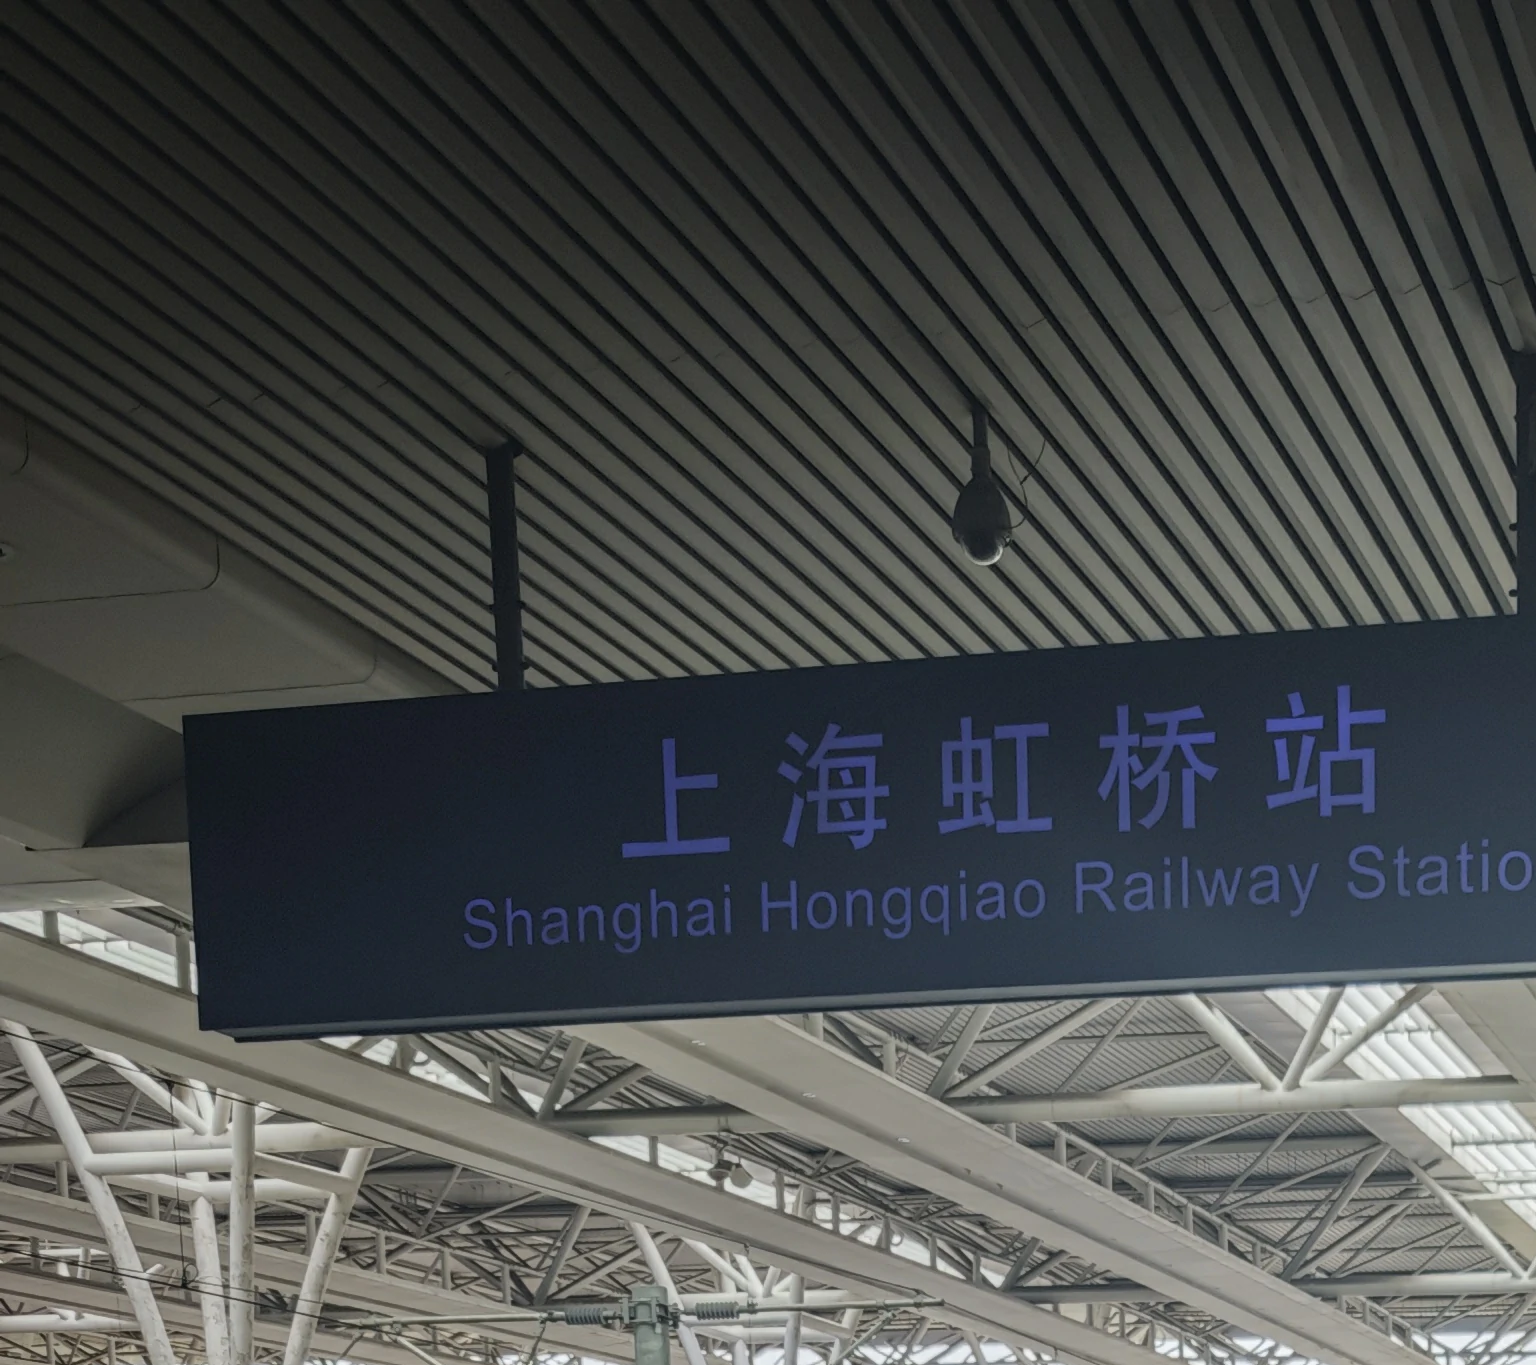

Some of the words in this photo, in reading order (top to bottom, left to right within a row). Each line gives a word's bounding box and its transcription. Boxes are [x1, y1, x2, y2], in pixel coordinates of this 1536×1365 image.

[622, 685, 1386, 857] 上海虹桥站
[463, 884, 732, 953] Shanghai
[761, 870, 1046, 939] Hongqiao
[1075, 857, 1319, 917] Railway
